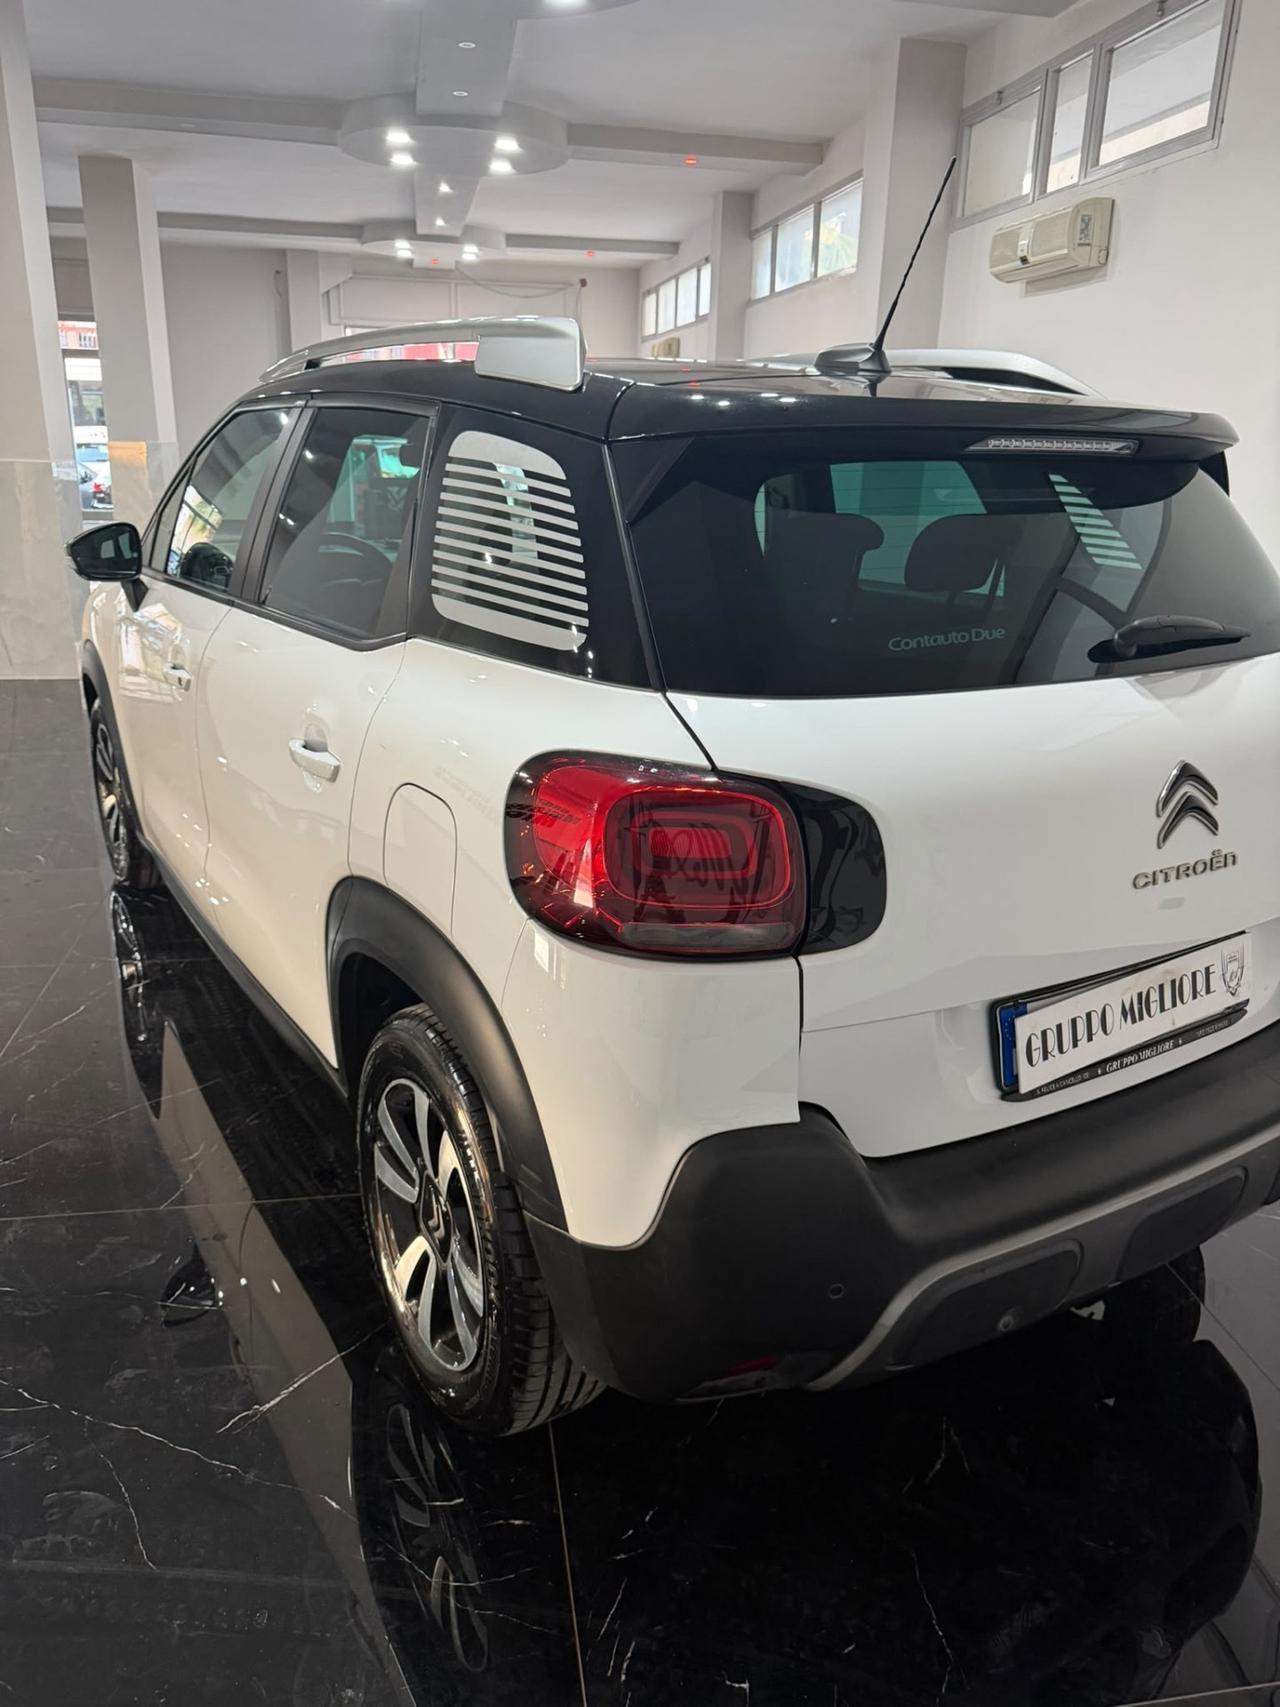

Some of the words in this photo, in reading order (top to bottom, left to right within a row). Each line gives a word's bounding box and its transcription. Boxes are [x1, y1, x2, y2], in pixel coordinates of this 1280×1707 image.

[888, 631, 969, 651] Contauto
[971, 628, 1006, 642] Due
[1025, 1003, 1115, 1068] GRUPPO
[1119, 963, 1216, 1030] MIGLIORE
[1106, 1054, 1138, 1072] GRUPPO
[1140, 1040, 1175, 1059] MIGLIORE
